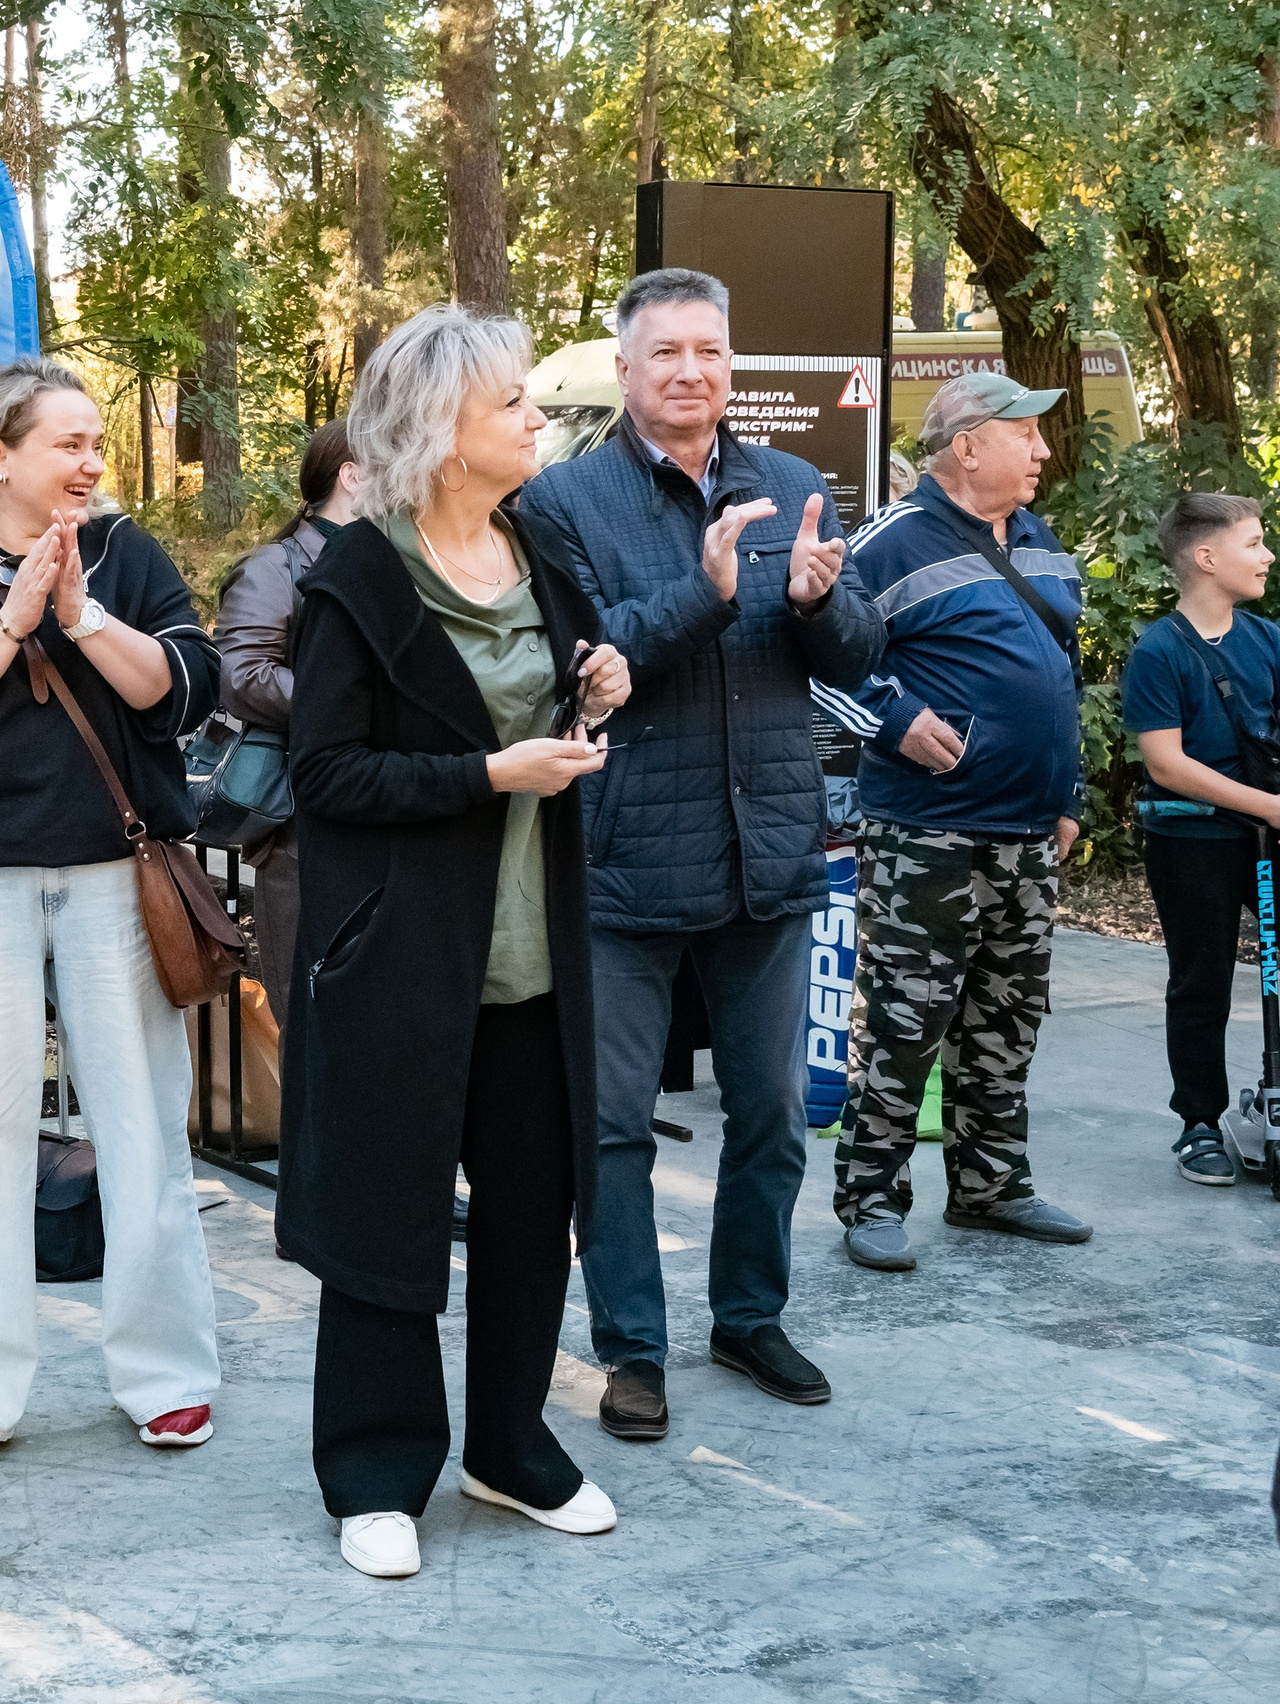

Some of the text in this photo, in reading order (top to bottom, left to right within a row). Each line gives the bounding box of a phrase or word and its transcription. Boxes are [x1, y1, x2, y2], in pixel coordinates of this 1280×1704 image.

[892, 358, 1007, 380] ИЦИНСКАЯ
[726, 391, 795, 403] РАВИЛА
[721, 405, 820, 419] ОВЕДЕНИЯ
[728, 420, 814, 432] ЭКСТРИМ-
[737, 435, 771, 446] РКЕ
[807, 890, 857, 1074] PEPSI
